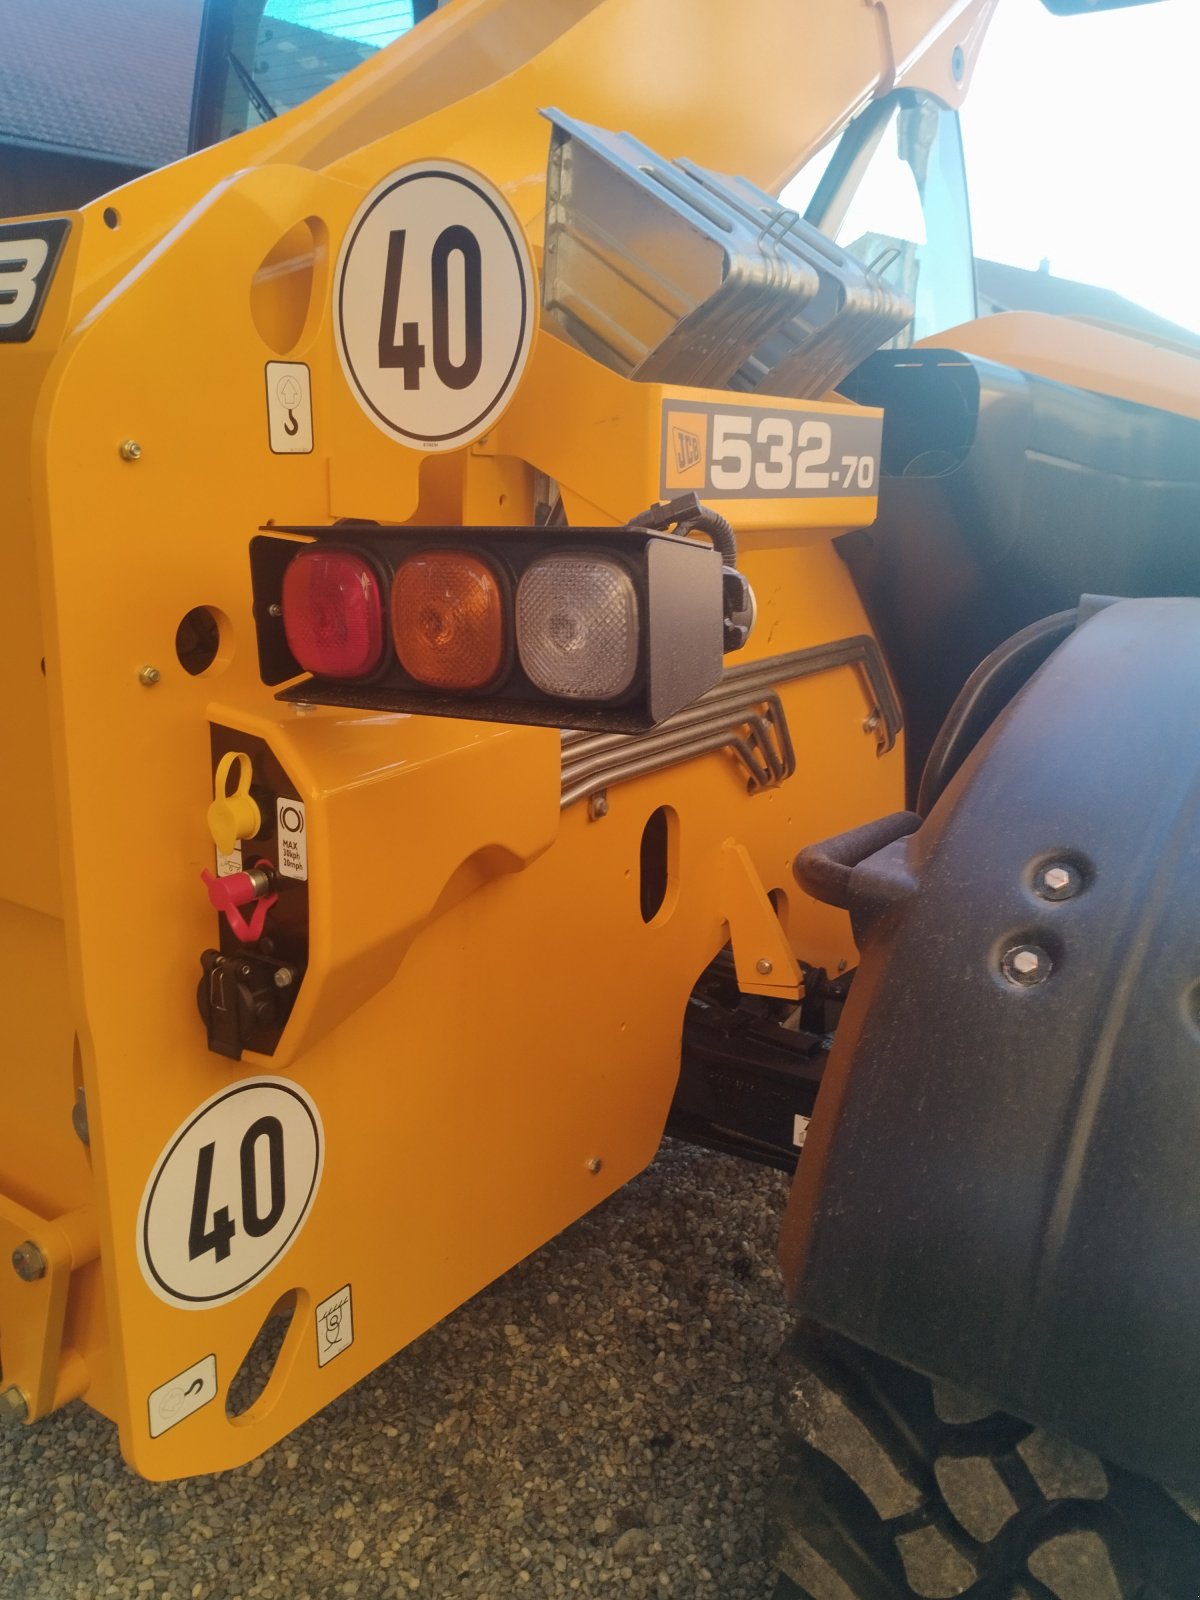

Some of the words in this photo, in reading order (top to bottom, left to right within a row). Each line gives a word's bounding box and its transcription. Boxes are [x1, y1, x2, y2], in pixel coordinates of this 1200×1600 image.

[379, 224, 483, 391] 40
[675, 430, 700, 470] JCB
[282, 839, 298, 851] MAX
[188, 1115, 286, 1264] 40
